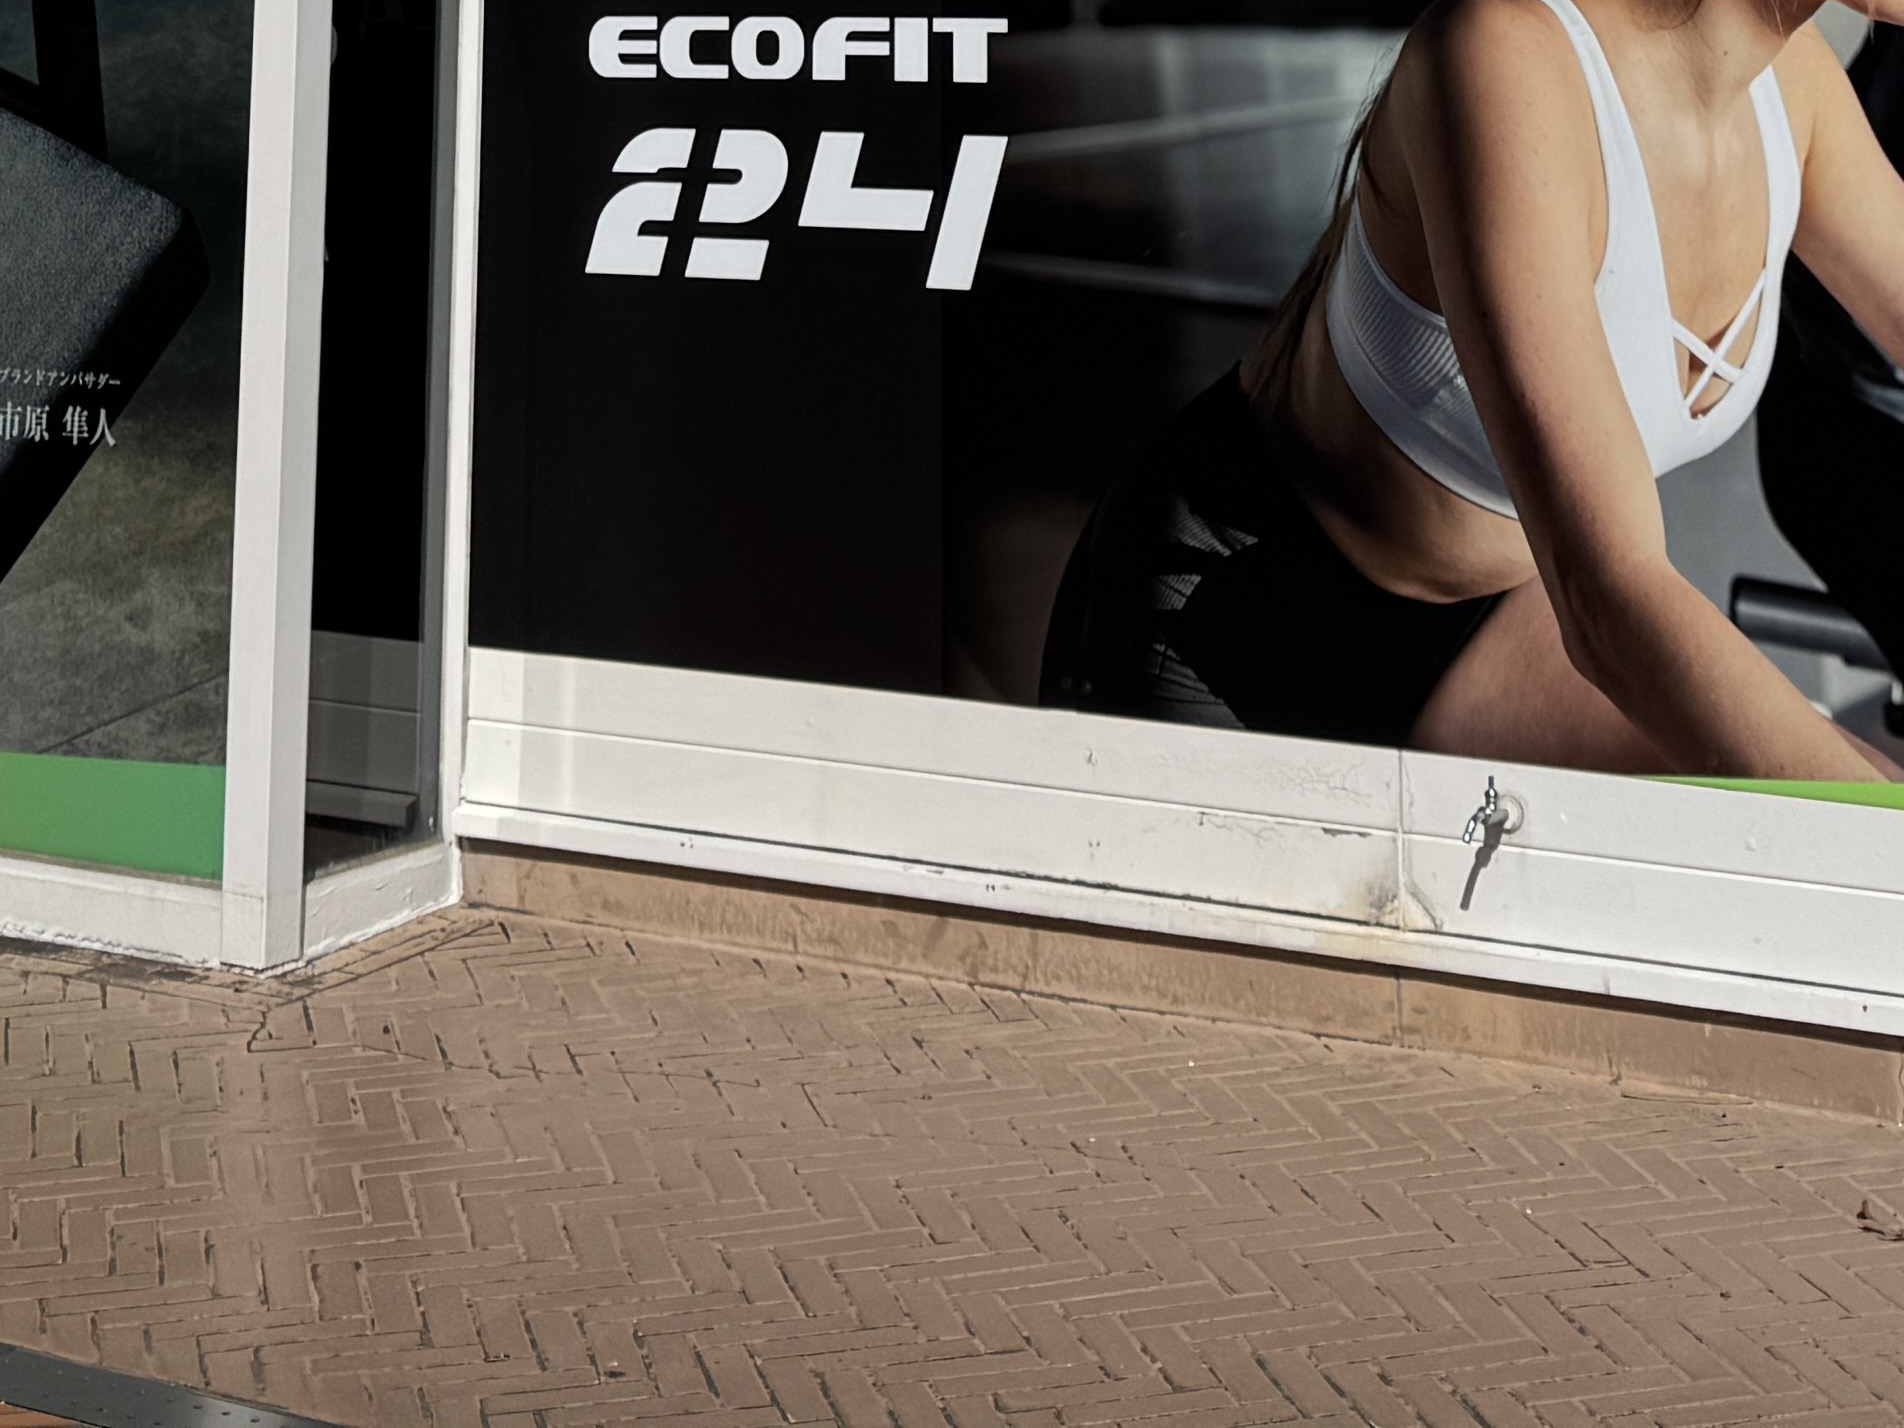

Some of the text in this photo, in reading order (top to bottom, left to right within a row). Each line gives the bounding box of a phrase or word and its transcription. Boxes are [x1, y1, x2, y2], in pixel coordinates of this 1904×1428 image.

[588, 15, 1009, 84] ECOFIT
[584, 127, 1009, 291] 24
[61, 404, 117, 447] 隼人
